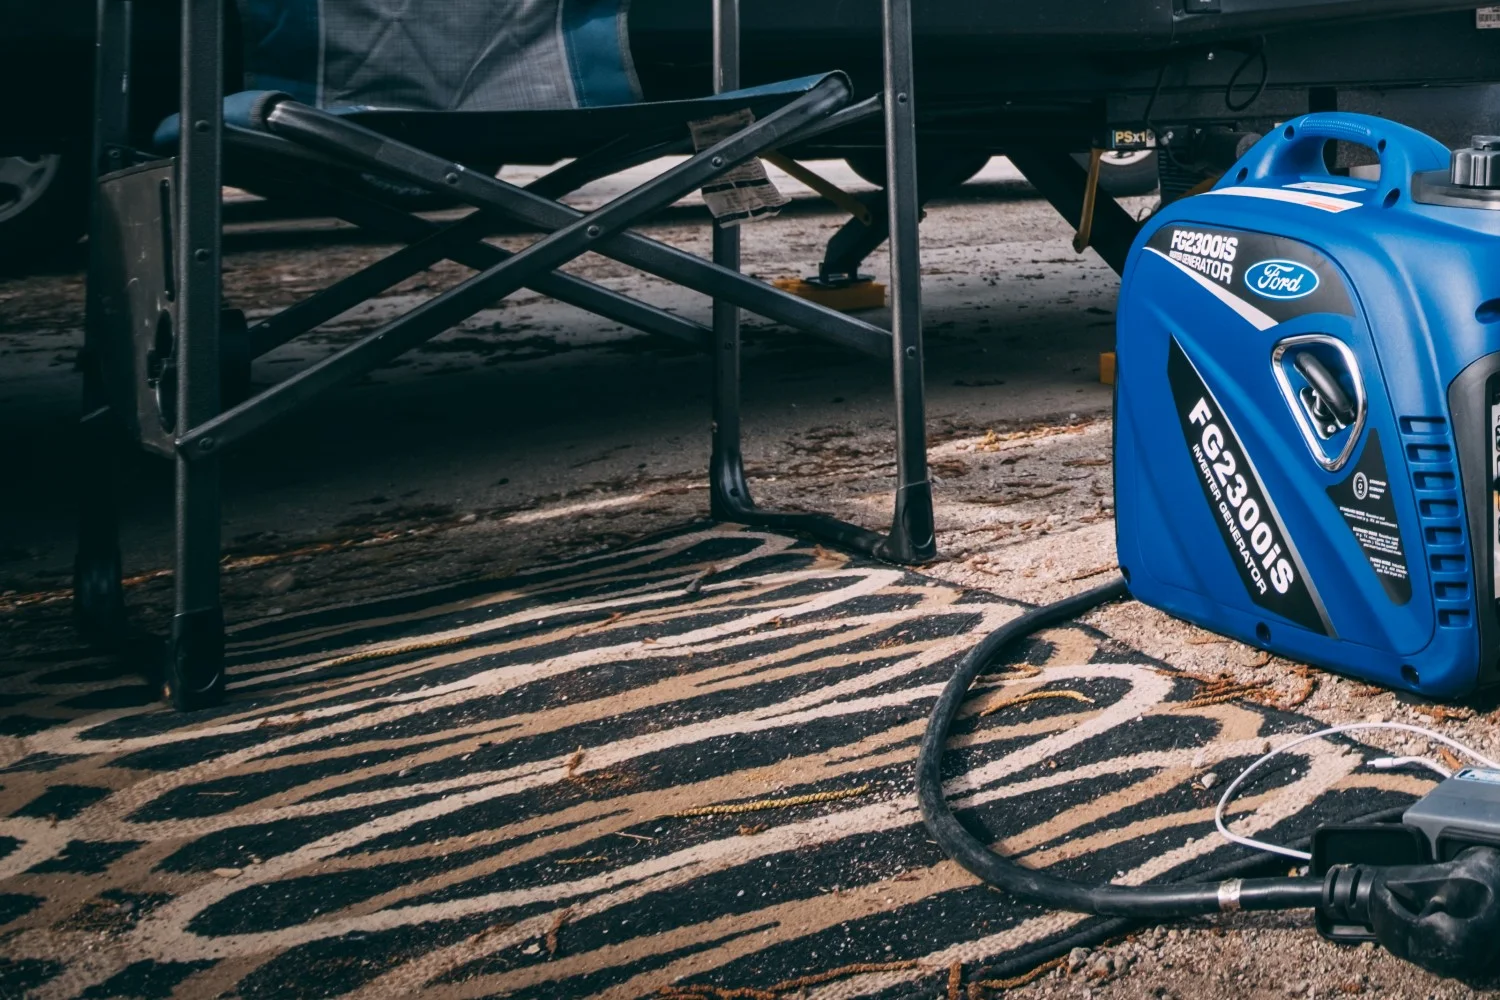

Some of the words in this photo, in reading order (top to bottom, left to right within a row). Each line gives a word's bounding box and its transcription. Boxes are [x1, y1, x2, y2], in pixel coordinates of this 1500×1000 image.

[1115, 131, 1146, 144] PSx1
[1171, 230, 1238, 261] FG2300iS
[1181, 253, 1233, 284] GENERATOR
[1257, 264, 1304, 292] Ford
[1189, 397, 1294, 594] FG2300iS
[1192, 443, 1222, 501] INVERTER
[1219, 502, 1268, 595] GENERATOR
